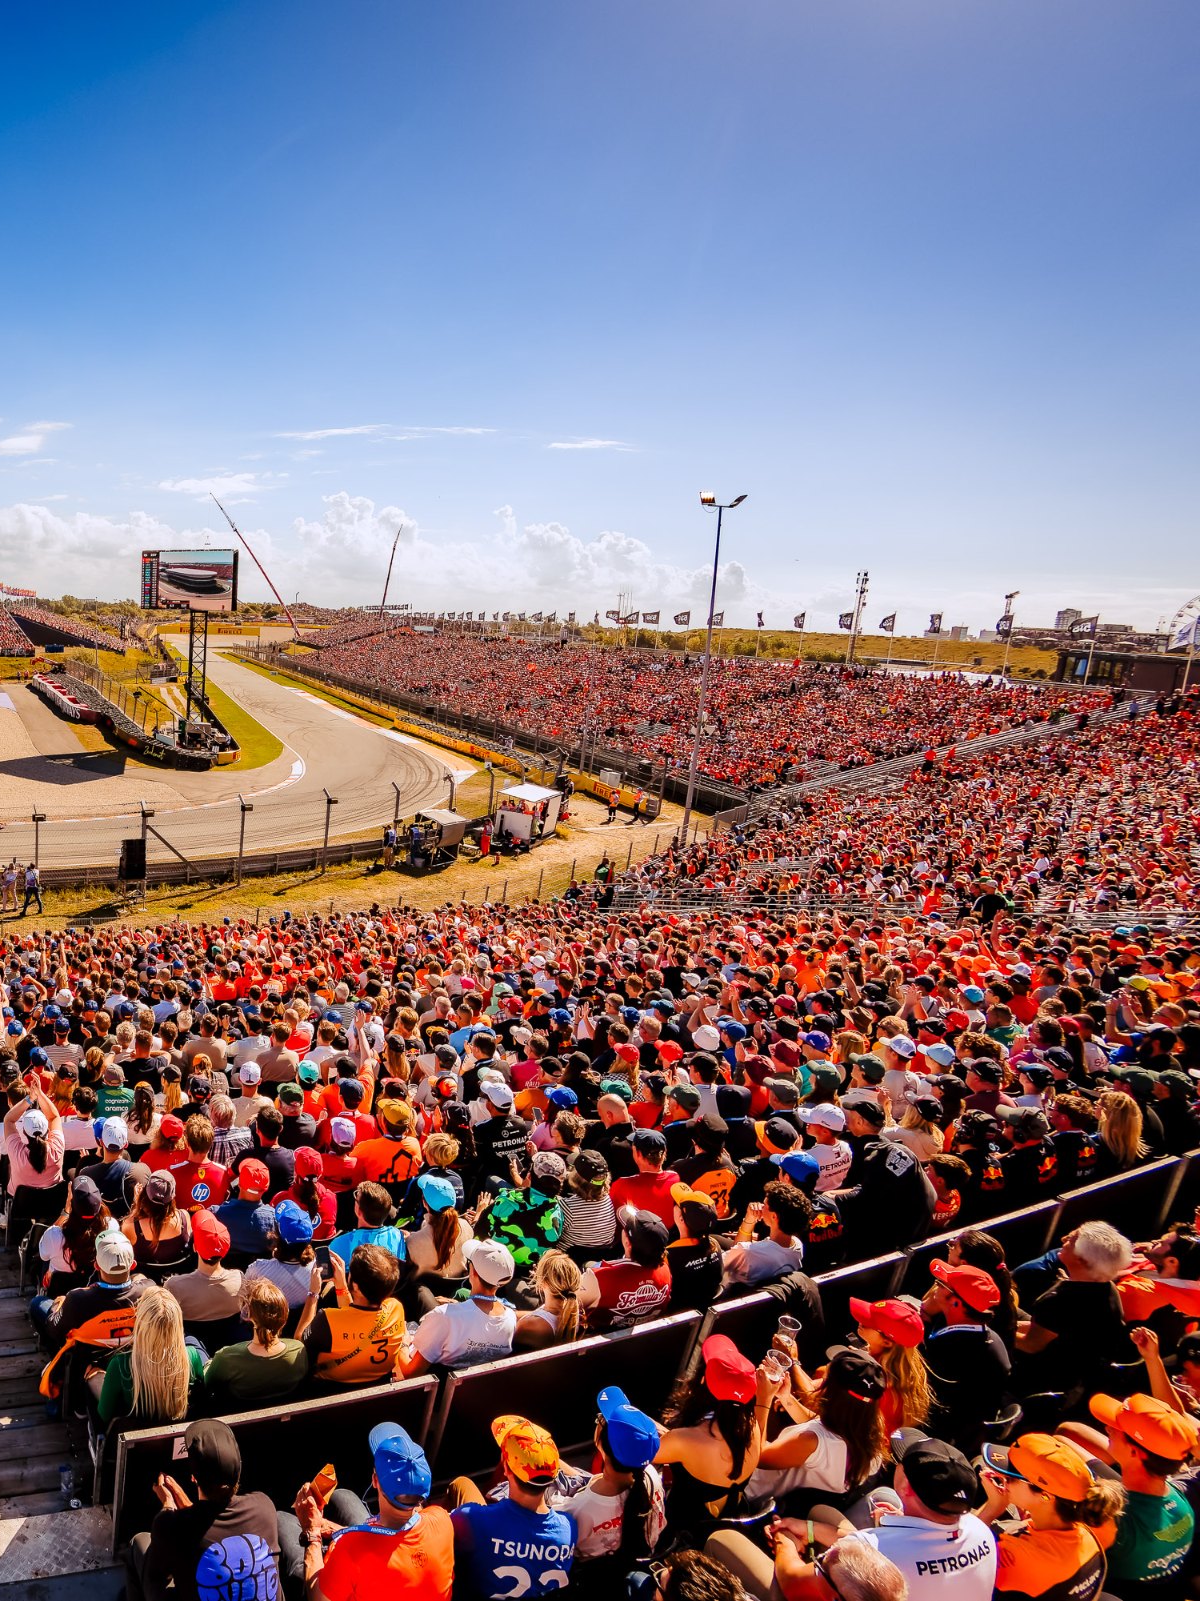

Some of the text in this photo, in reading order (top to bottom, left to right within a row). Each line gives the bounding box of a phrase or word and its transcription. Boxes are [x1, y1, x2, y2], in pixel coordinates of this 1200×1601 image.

[193, 1184, 209, 1202] hp
[370, 1338, 389, 1364] 3
[990, 1452, 1006, 1463] 4
[915, 1543, 991, 1577] PETRONAS
